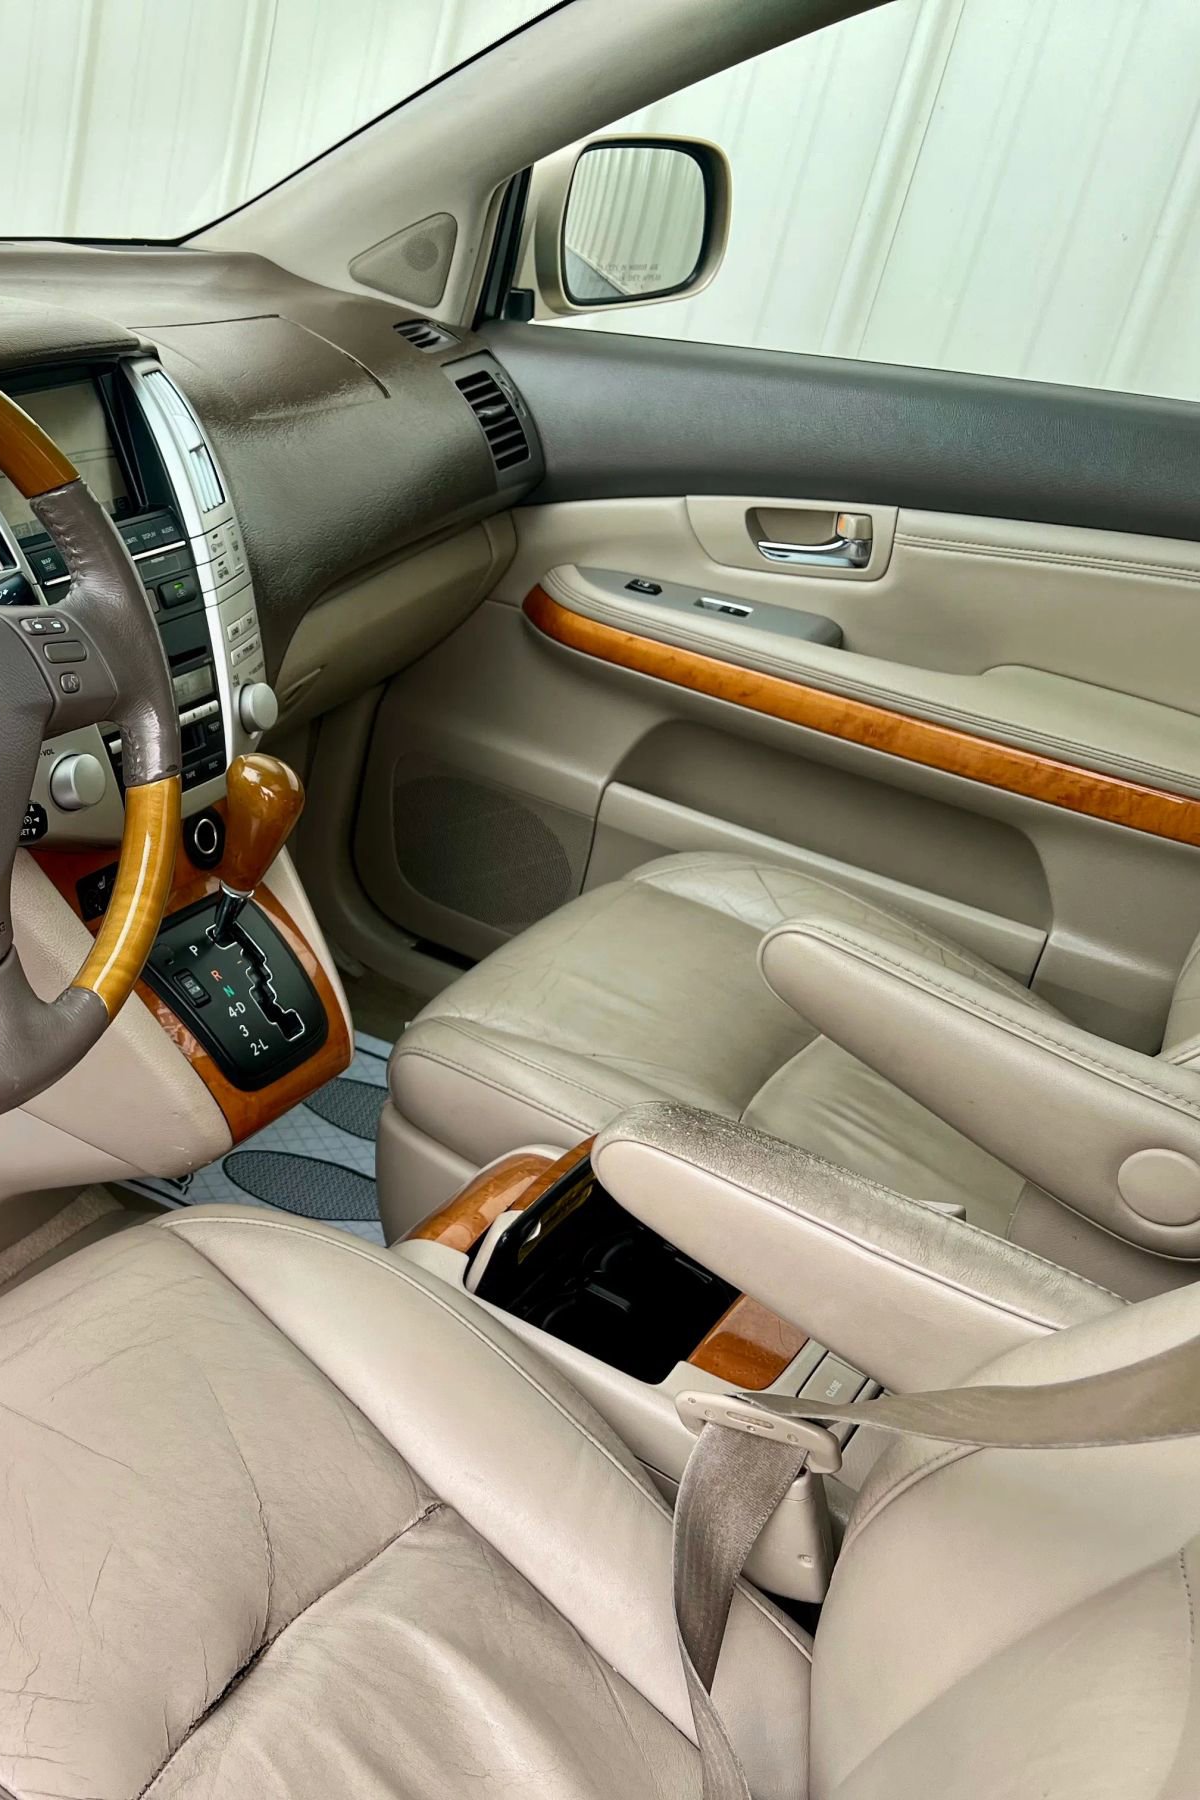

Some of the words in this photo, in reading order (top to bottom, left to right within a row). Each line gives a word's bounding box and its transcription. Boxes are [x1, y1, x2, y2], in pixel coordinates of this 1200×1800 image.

[188, 944, 199, 957] P
[210, 969, 223, 982] R
[223, 984, 235, 998] N
[228, 1001, 246, 1018] 4-D
[239, 1024, 250, 1037] 3
[250, 1038, 269, 1057] 2-L
[825, 1379, 843, 1398] CLOSE
